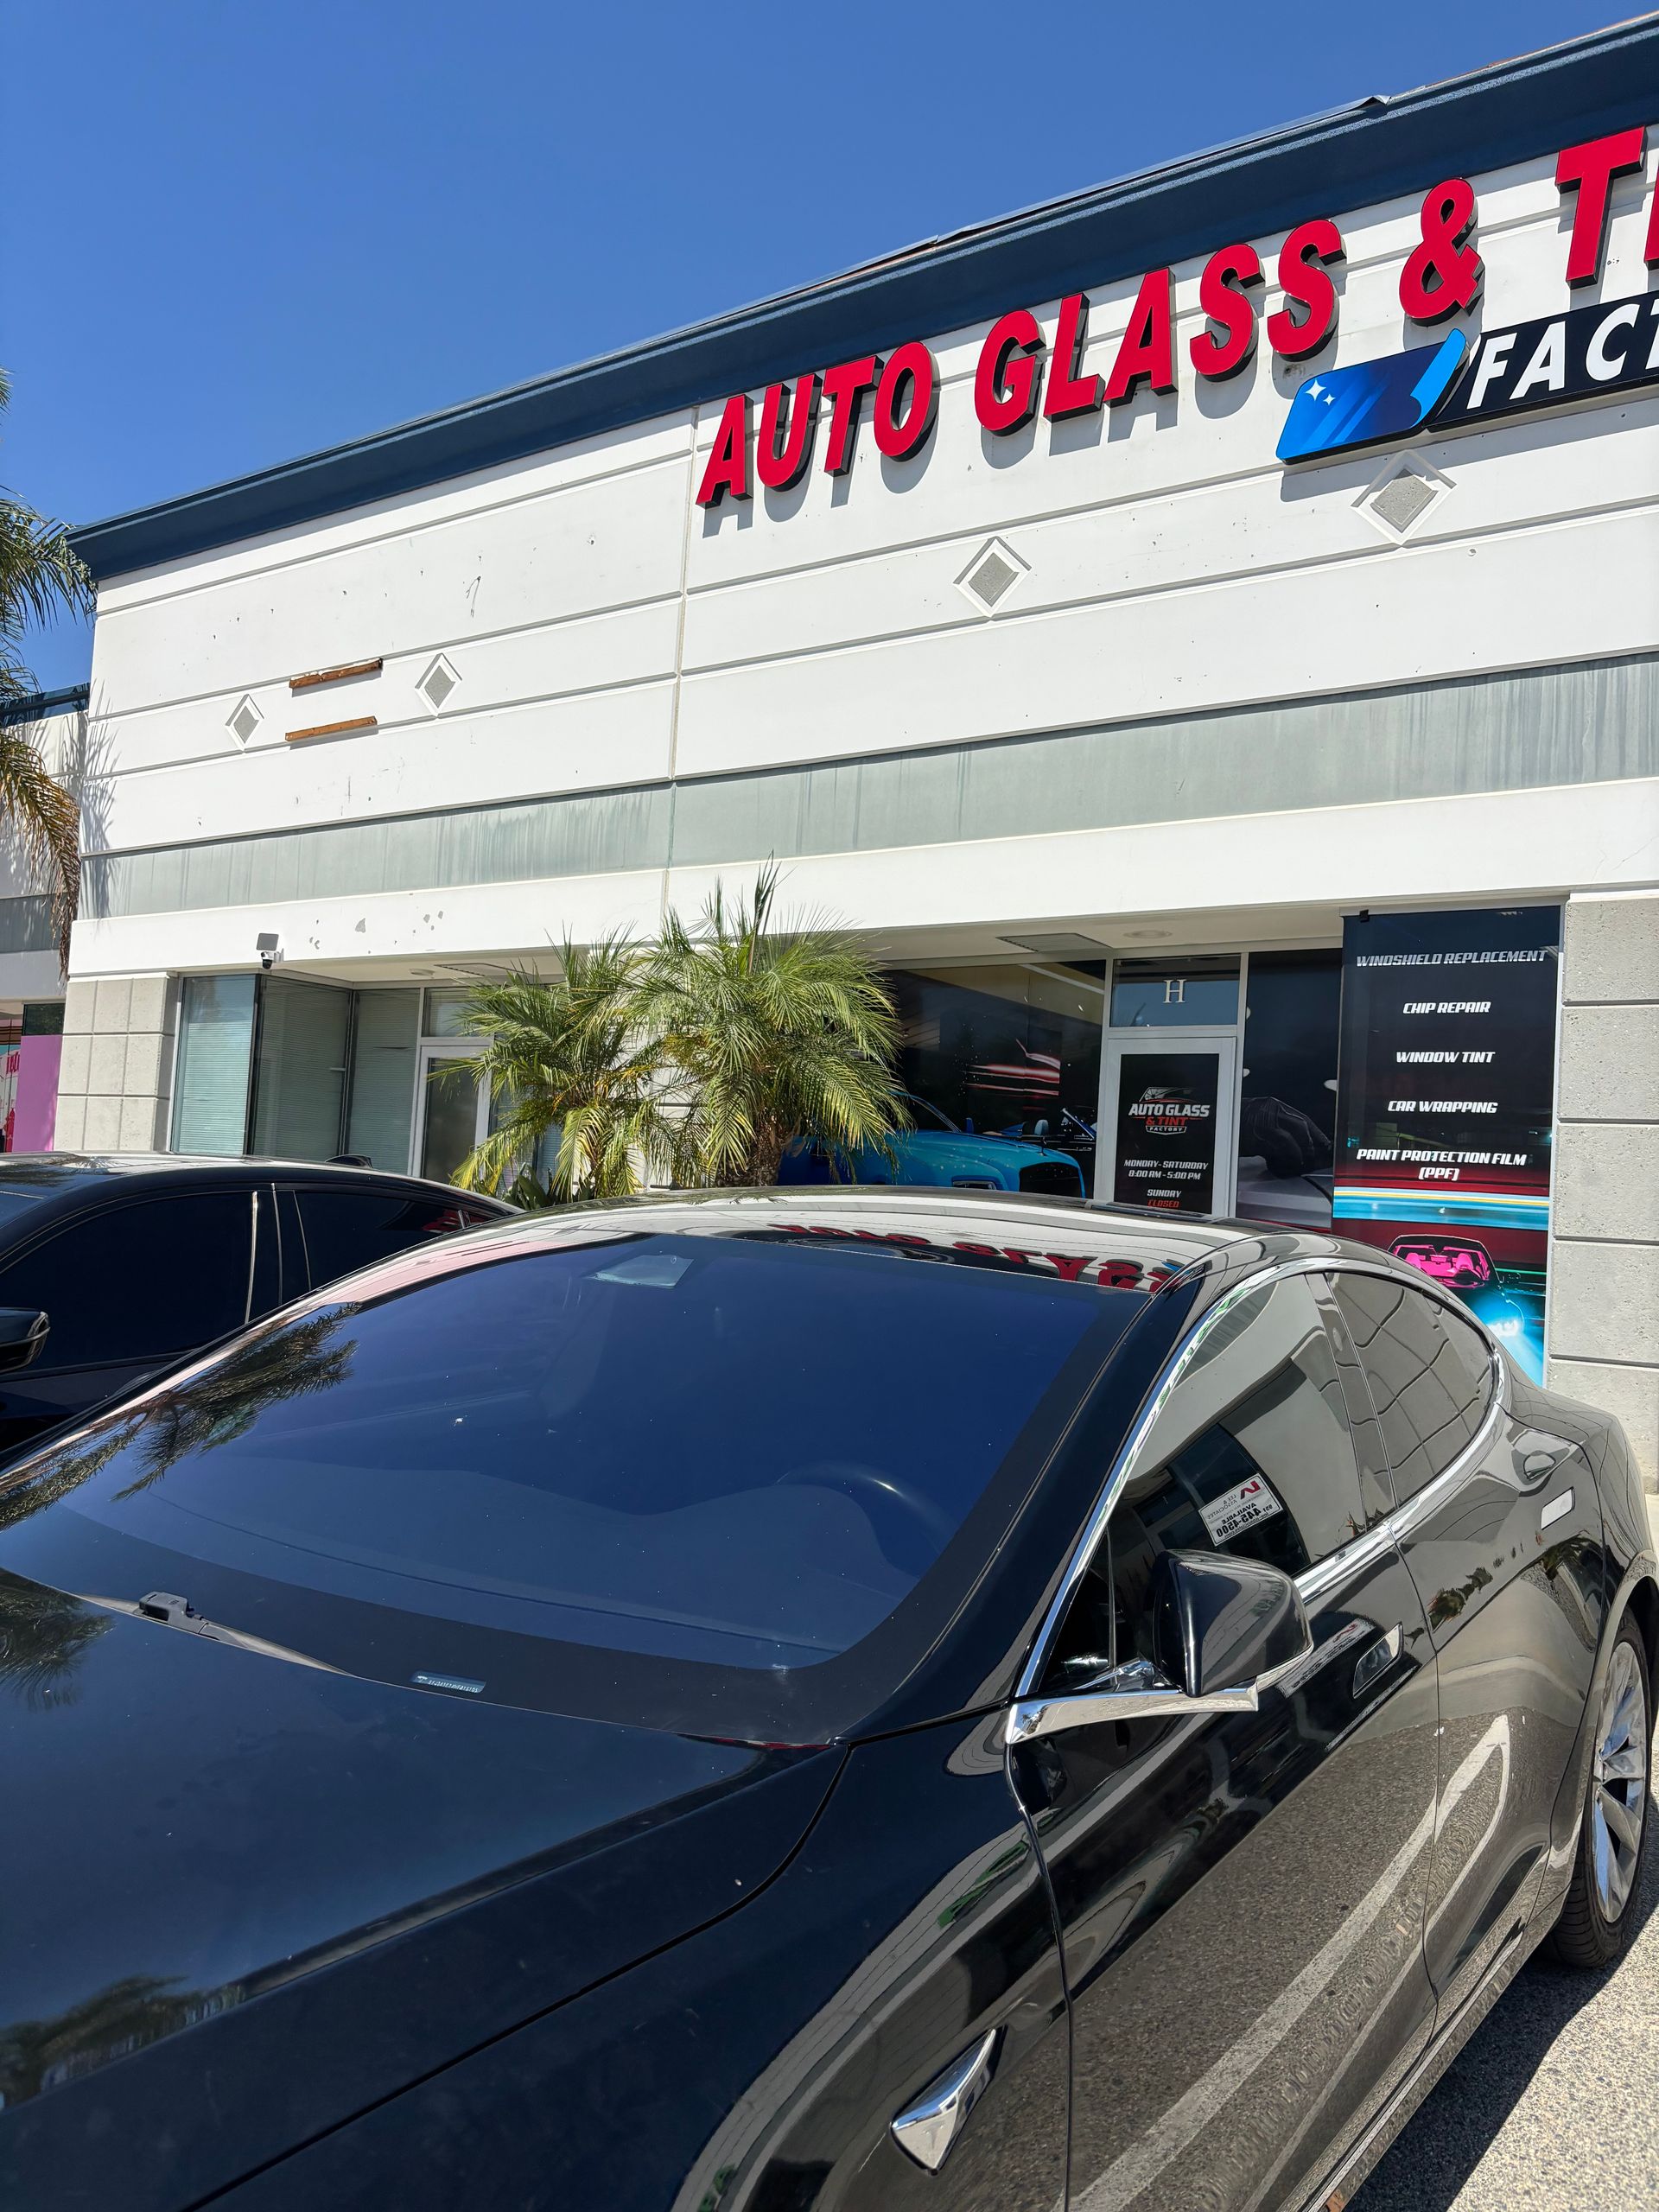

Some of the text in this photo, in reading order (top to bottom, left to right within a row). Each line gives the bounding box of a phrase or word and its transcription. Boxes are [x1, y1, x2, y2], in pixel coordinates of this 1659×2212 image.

[695, 341, 937, 508] AUTO
[975, 219, 1346, 435] GLASS
[1399, 178, 1484, 327] &
[1357, 950, 1548, 967] WINDSHIELD REPLACEMENT
[1162, 978, 1187, 1004] H
[1402, 1001, 1491, 1014] CHIP REPAIR
[1395, 1052, 1496, 1063] WINDOW TINT
[1128, 1103, 1211, 1117] AUTO GLASS
[1388, 1101, 1498, 1114] CAR WRAPPING
[1146, 1116, 1188, 1127] & TINT
[1356, 1149, 1528, 1166] PAINT PROTECTION FILM
[1128, 1169, 1148, 1178] 8:00
[1148, 1170, 1162, 1179] AM
[1166, 1171, 1187, 1179] 5:00
[1187, 1172, 1202, 1180] PM
[1147, 1189, 1182, 1198] SUNDAY
[1147, 1198, 1180, 1208] CLOSED
